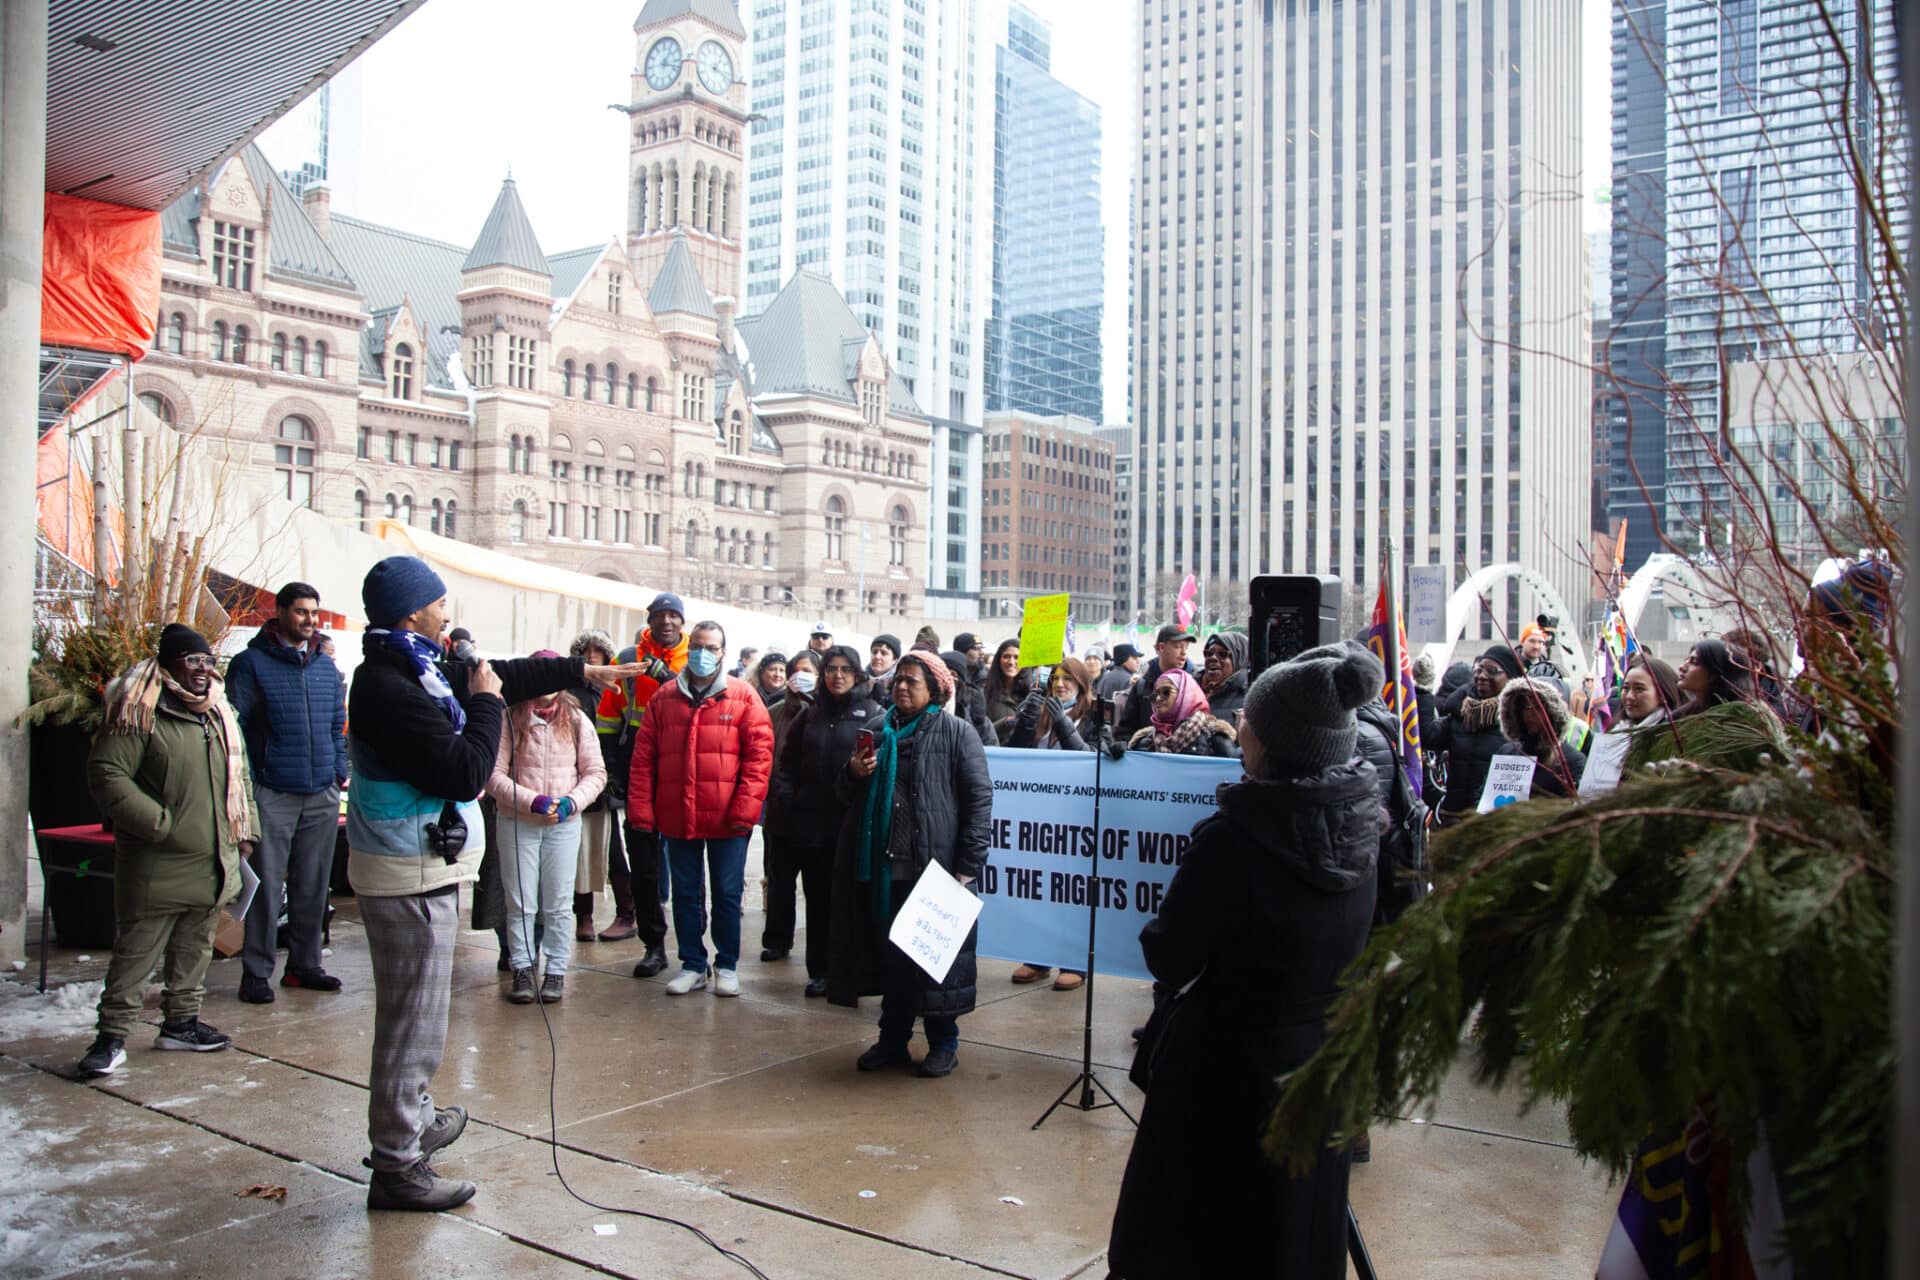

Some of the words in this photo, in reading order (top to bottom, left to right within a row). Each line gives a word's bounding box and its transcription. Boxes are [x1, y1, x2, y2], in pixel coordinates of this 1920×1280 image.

[1494, 763, 1530, 772] BUDGETS
[992, 780, 1018, 792] SIAN
[1020, 782, 1071, 795] WOMEN'S
[1073, 786, 1096, 797] AND
[1100, 787, 1169, 802] IMMIGRANTS'
[1171, 792, 1217, 806] SERVICE
[989, 819, 1011, 849] HE
[1018, 821, 1095, 858] RIGHTS
[1102, 828, 1130, 860] OF
[1137, 831, 1191, 866] WOR
[977, 865, 998, 895] ND
[1005, 866, 1043, 900] THE
[1050, 872, 1128, 910] RIGHTS
[1136, 881, 1163, 914] OF
[911, 936, 941, 965] MORE
